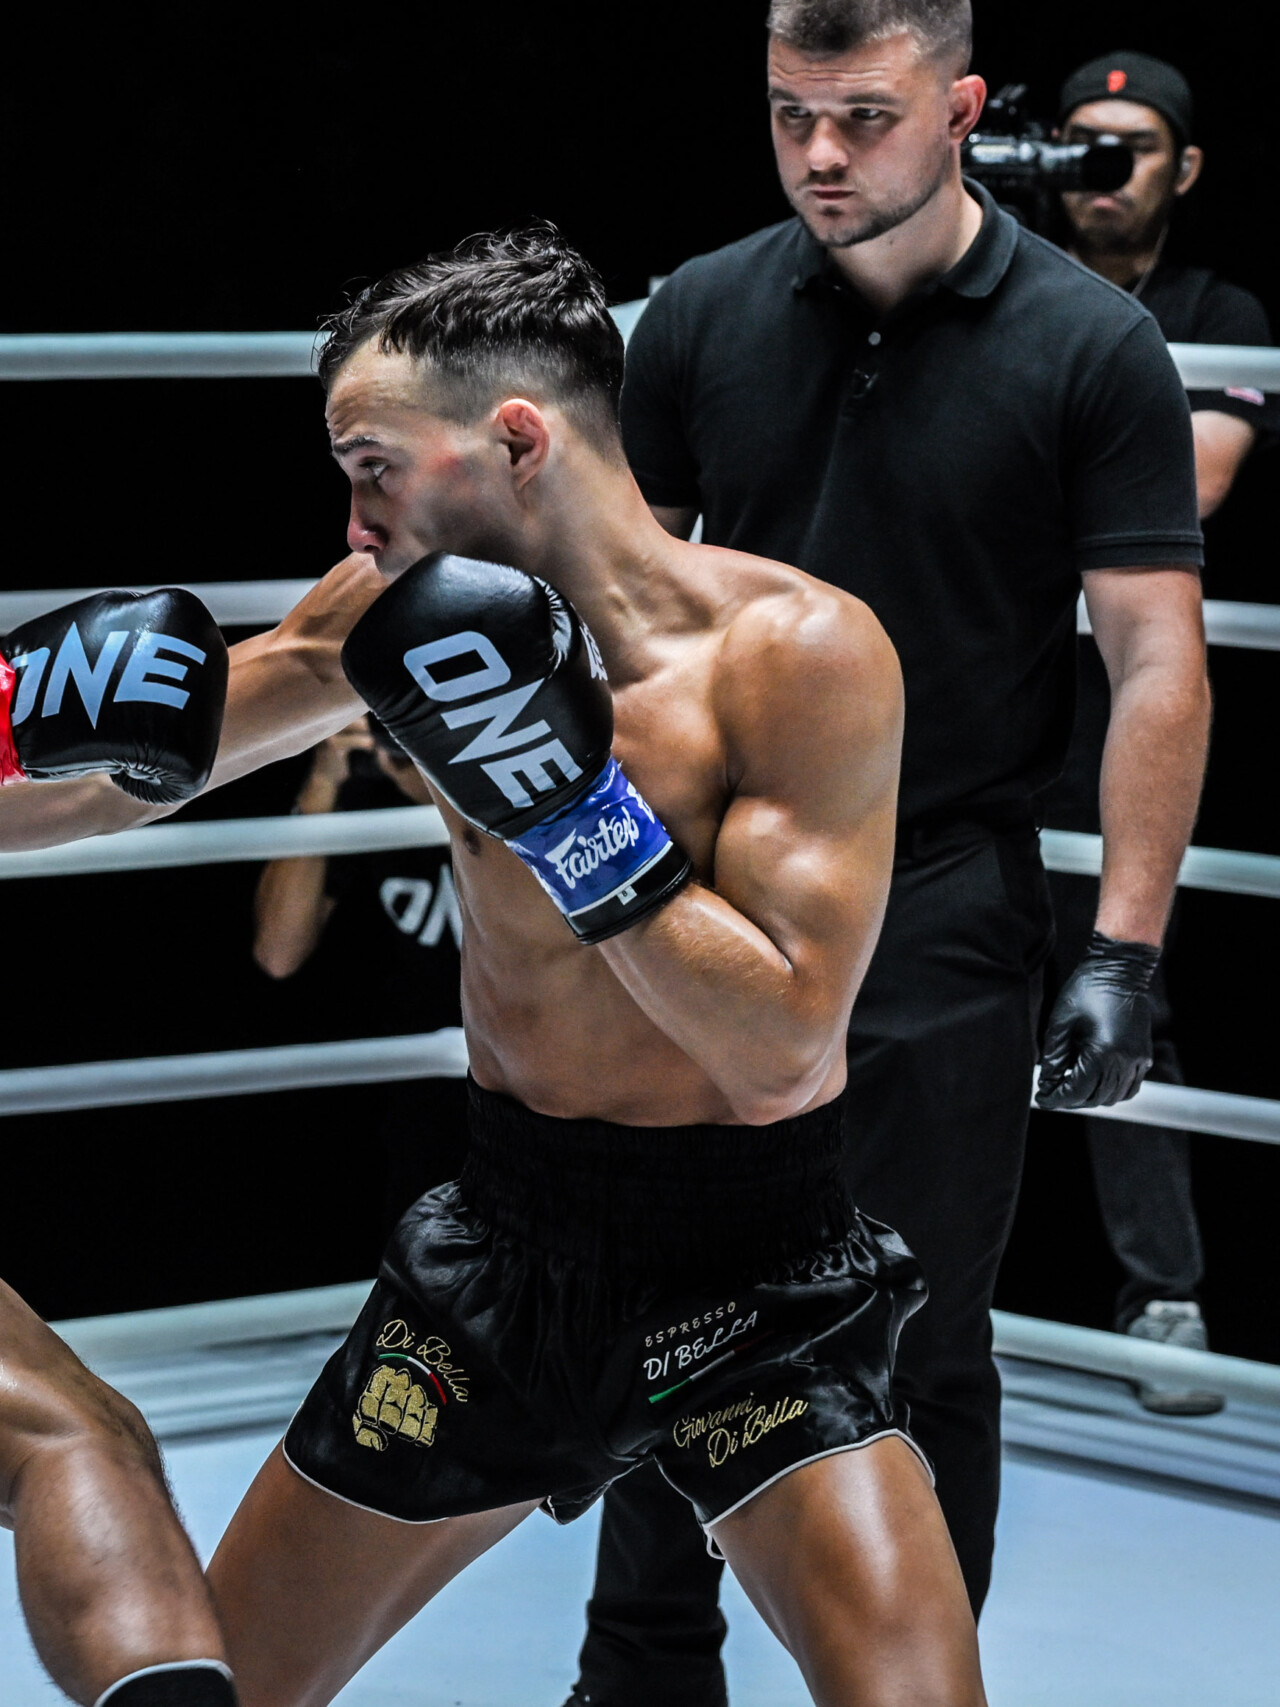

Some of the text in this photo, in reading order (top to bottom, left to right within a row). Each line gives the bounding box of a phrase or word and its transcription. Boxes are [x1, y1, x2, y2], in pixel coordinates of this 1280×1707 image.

[403, 631, 584, 808] ONE
[544, 806, 639, 889] Fairtex
[643, 1310, 758, 1380] DI BELLA
[645, 1302, 736, 1347] ESPRESSO
[376, 1319, 470, 1402] Di Bella
[673, 1392, 756, 1448] Giovanni
[707, 1396, 808, 1467] Di Bella
